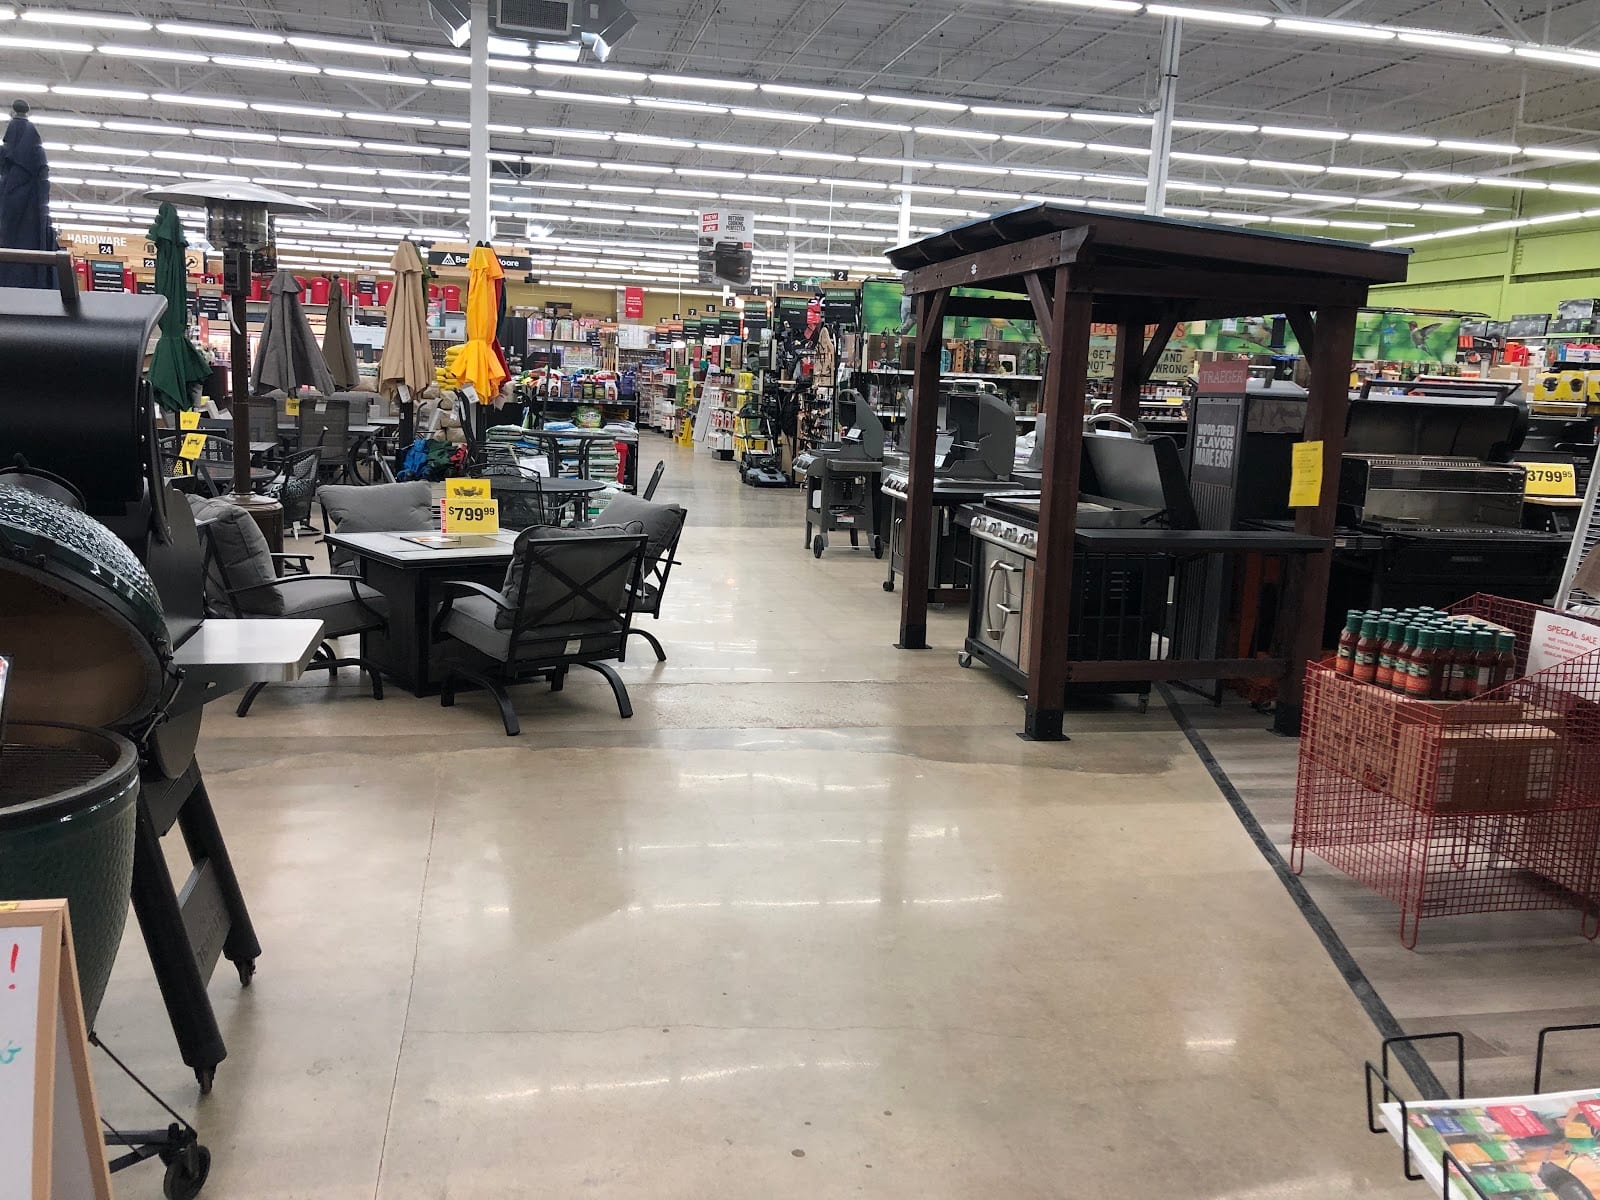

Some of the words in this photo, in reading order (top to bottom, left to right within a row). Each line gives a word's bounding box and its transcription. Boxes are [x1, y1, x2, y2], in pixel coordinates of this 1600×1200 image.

[66, 233, 127, 247] HARDWARE
[100, 246, 112, 254] 24
[144, 259, 155, 267] 23
[838, 271, 844, 280] 2
[753, 288, 759, 296] 4
[792, 283, 798, 291] 3
[1092, 350, 1111, 360] GET
[1164, 353, 1182, 363] AND
[1202, 370, 1243, 384] TRAEGER
[1197, 423, 1235, 437] WOOD-FIRED
[1196, 435, 1234, 449] FLAVOR
[1195, 447, 1213, 466] MADE
[1215, 449, 1233, 468] EASY
[1547, 624, 1579, 639] SPECIAL
[1581, 633, 1599, 645] SALE
